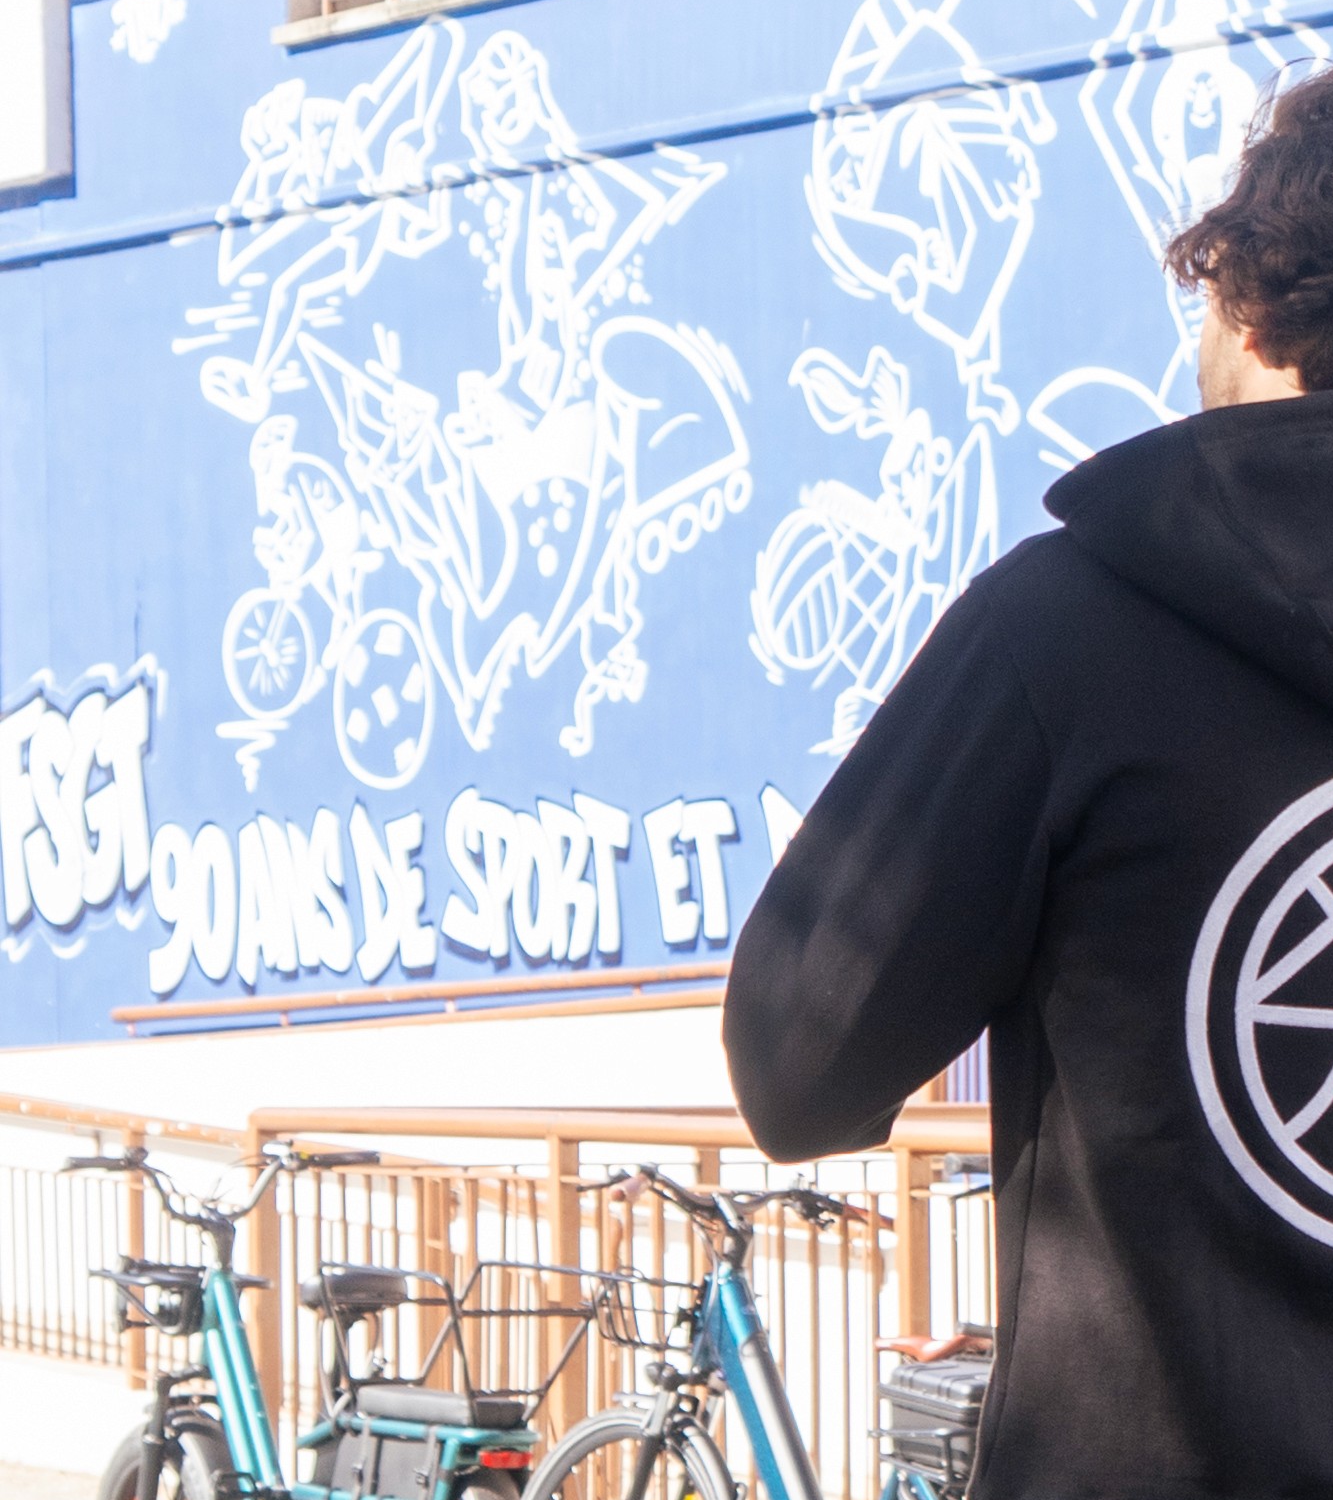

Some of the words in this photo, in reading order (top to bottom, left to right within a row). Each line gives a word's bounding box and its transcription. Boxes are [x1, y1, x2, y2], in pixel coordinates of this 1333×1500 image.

[0, 685, 150, 926] FSGT
[149, 822, 235, 994] 90
[237, 807, 354, 986] ANS
[349, 803, 437, 982] DE
[441, 787, 630, 961] SPORT
[644, 799, 735, 943] ET
